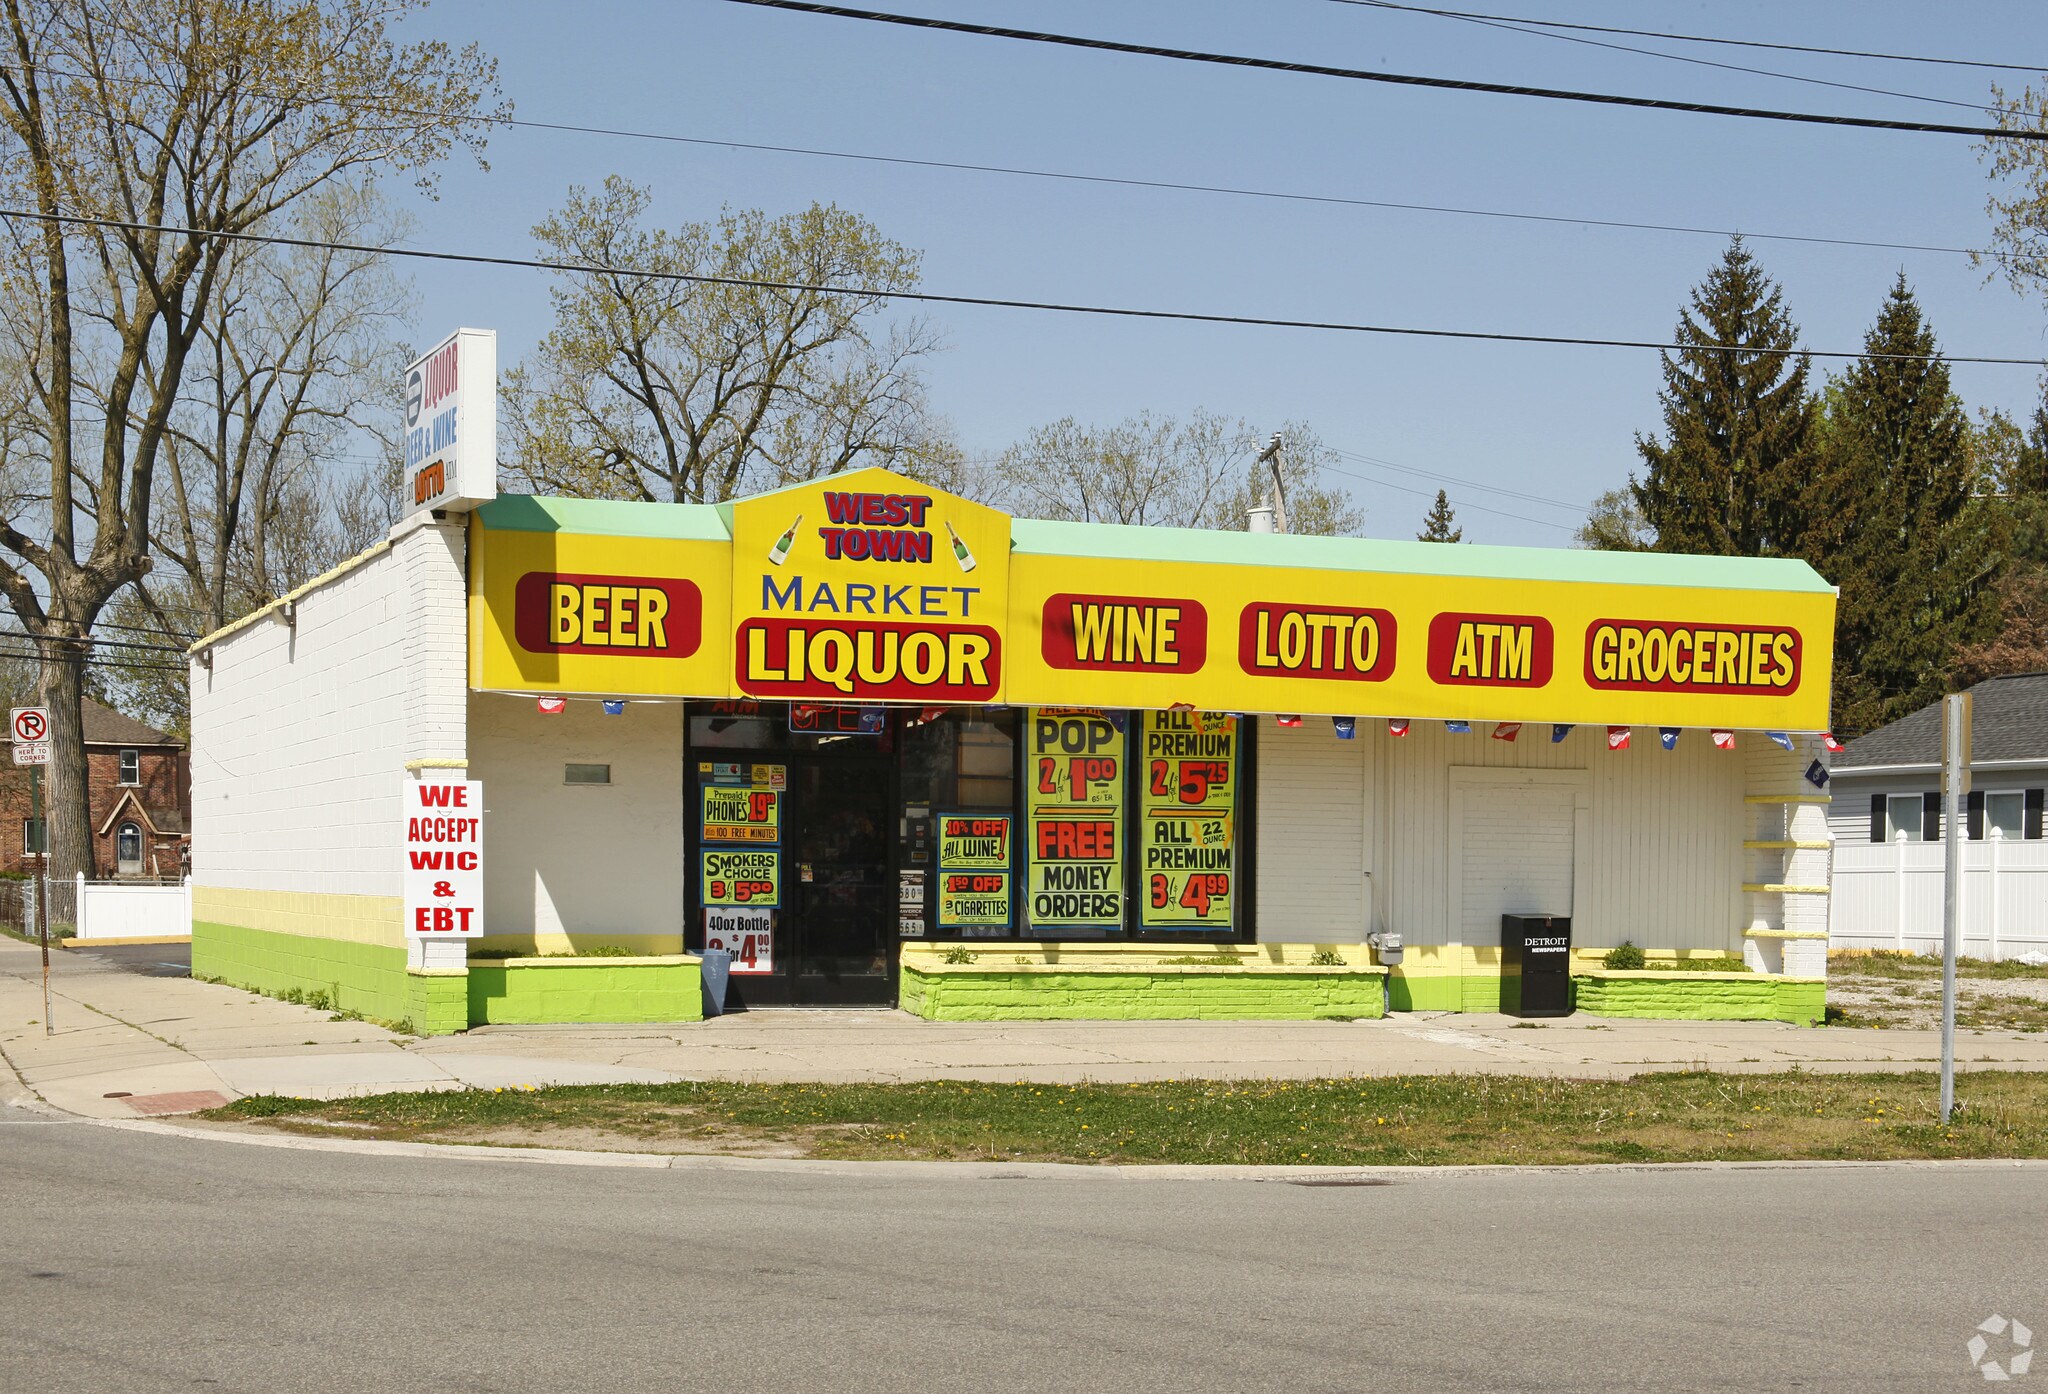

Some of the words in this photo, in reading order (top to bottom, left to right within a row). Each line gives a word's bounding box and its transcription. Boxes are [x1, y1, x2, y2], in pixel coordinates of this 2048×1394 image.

[424, 342, 458, 409] LIQUOR
[406, 427, 423, 470] BEER
[424, 428, 431, 458] &
[433, 406, 457, 454] WINE
[415, 459, 444, 506] LOTTO
[445, 459, 457, 482] ATM
[823, 491, 932, 528] WEST
[819, 527, 932, 563] TOWN
[761, 574, 981, 617] MARKET
[549, 582, 669, 649] BEER
[1071, 602, 1182, 666] WINE
[1255, 609, 1380, 673] LOTTO
[746, 627, 992, 693] LIQUOR
[1450, 621, 1534, 681] ATM
[1591, 624, 1795, 687] GROCERIES
[1156, 710, 1192, 730] ALL
[1203, 721, 1225, 732] OUNCE
[1036, 718, 1114, 753] POP
[1149, 734, 1231, 756] PREMIUM
[1038, 757, 1056, 794] 2
[1150, 759, 1169, 796] 2
[419, 785, 467, 807] WE
[714, 790, 743, 800] Prepaid
[706, 800, 747, 821] PHONES
[408, 817, 478, 842] ACCEPT
[716, 827, 727, 837] 100
[732, 828, 746, 837] FREE
[750, 829, 775, 839] MINUTES
[945, 820, 969, 837] 10%
[1155, 821, 1192, 843] ALL
[1202, 821, 1223, 836] 22
[1203, 834, 1225, 845] OUNCE
[1037, 821, 1114, 860] FREE
[409, 851, 477, 870] WIC
[706, 854, 775, 877] SMOKERS
[1147, 848, 1231, 869] PREMIUM
[724, 869, 770, 879] CHOICE
[972, 876, 1003, 893] OFF
[1044, 866, 1111, 890] MONEY
[433, 881, 456, 897] &
[711, 880, 726, 899] 3
[1151, 873, 1168, 909] 3
[946, 900, 953, 909] 3
[955, 900, 1007, 916] CIGARETTES
[1035, 894, 1120, 917] ORDERS
[415, 907, 474, 931] EBT
[709, 916, 735, 931] 40oz
[737, 916, 770, 931] Bottle
[732, 934, 739, 943] $
[1524, 937, 1567, 946] DETROIT
